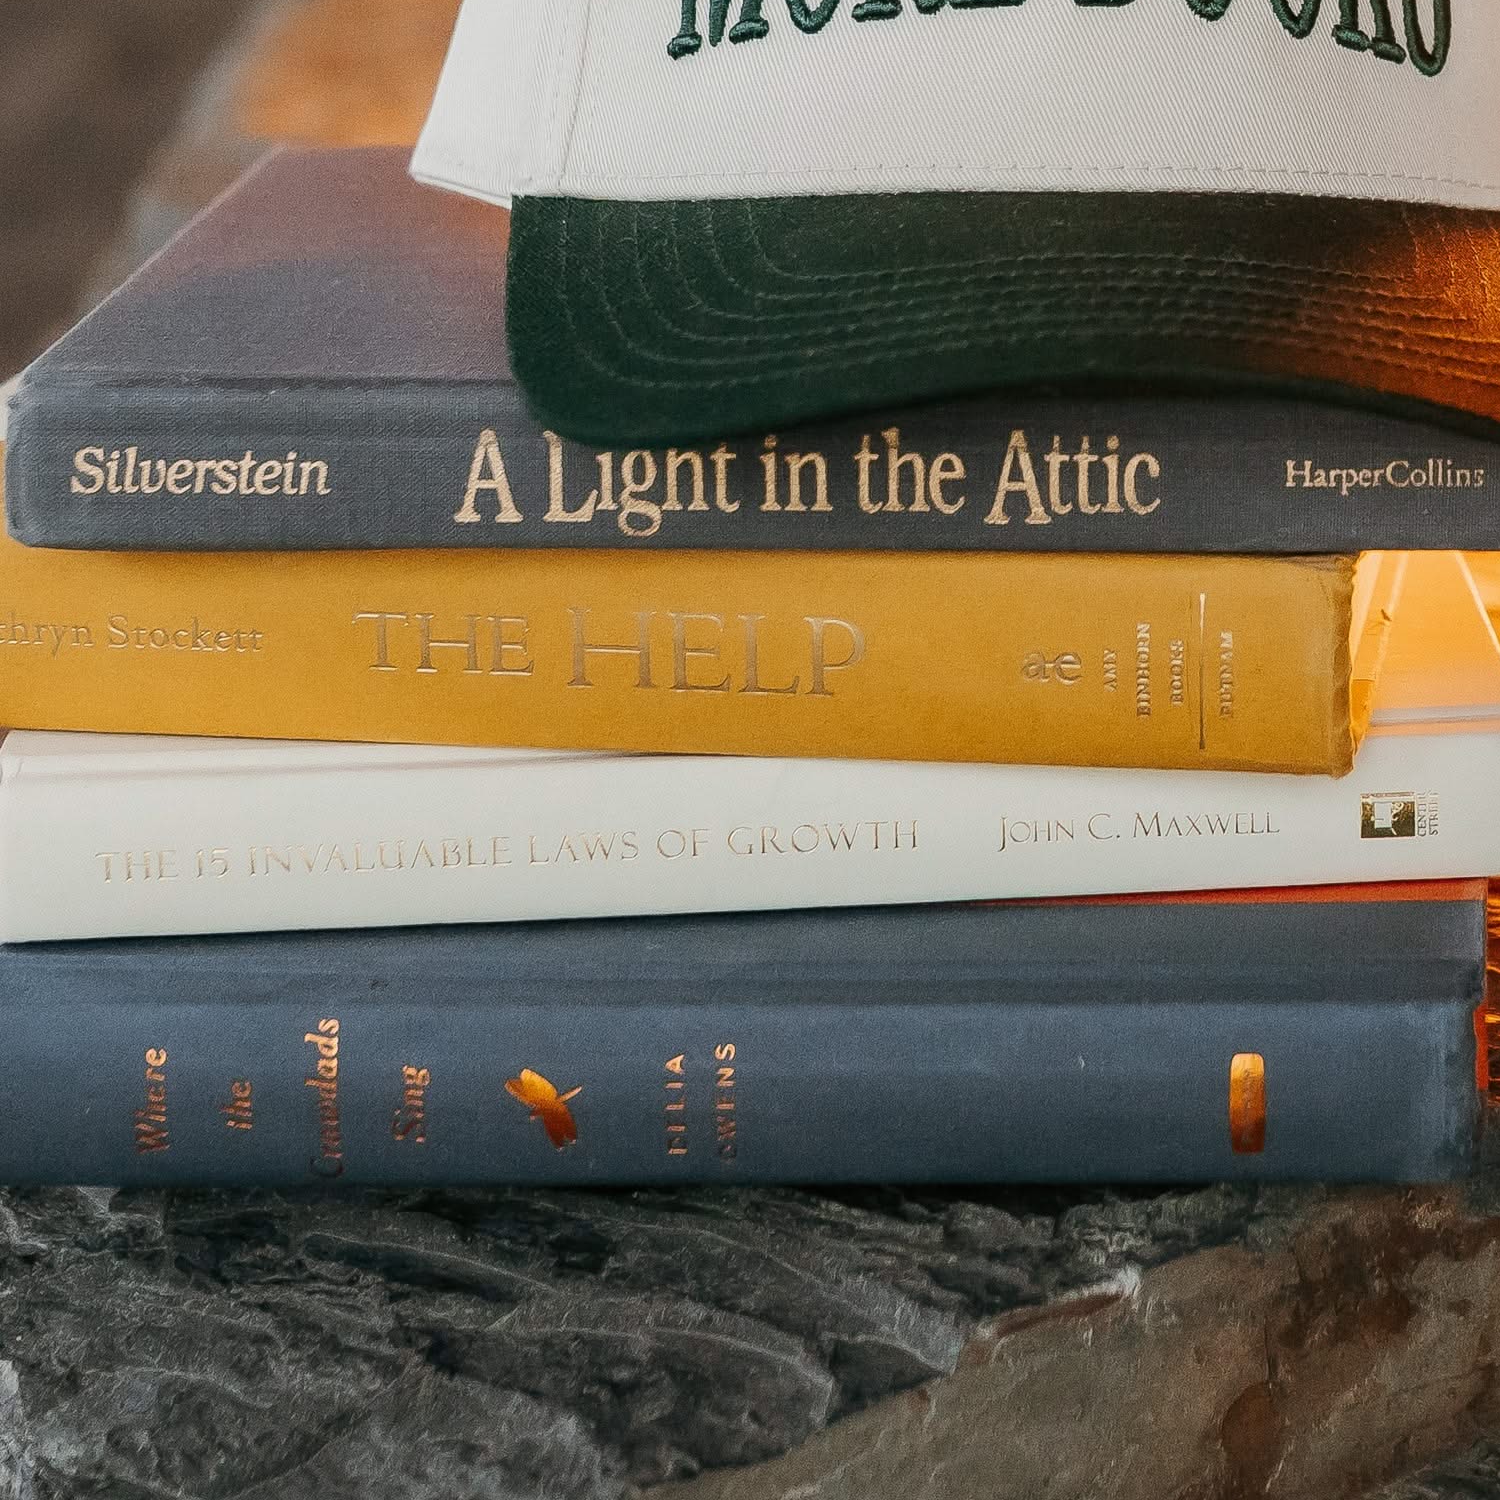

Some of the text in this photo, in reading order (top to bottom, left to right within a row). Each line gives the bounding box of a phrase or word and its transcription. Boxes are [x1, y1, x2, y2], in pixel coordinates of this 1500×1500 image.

[70, 446, 331, 497] Silverstein
[453, 428, 524, 523] A
[759, 434, 834, 513] in
[854, 426, 966, 516] the
[984, 428, 1162, 527] Attic
[1285, 458, 1486, 497] HarperCollins
[106, 613, 265, 653] Stockett
[351, 605, 867, 698] THE HELP
[95, 819, 920, 883] THE 15 INVALUABLE LAWS OF GROWTH
[997, 815, 1076, 852] JOHN
[1087, 812, 1122, 841] C.
